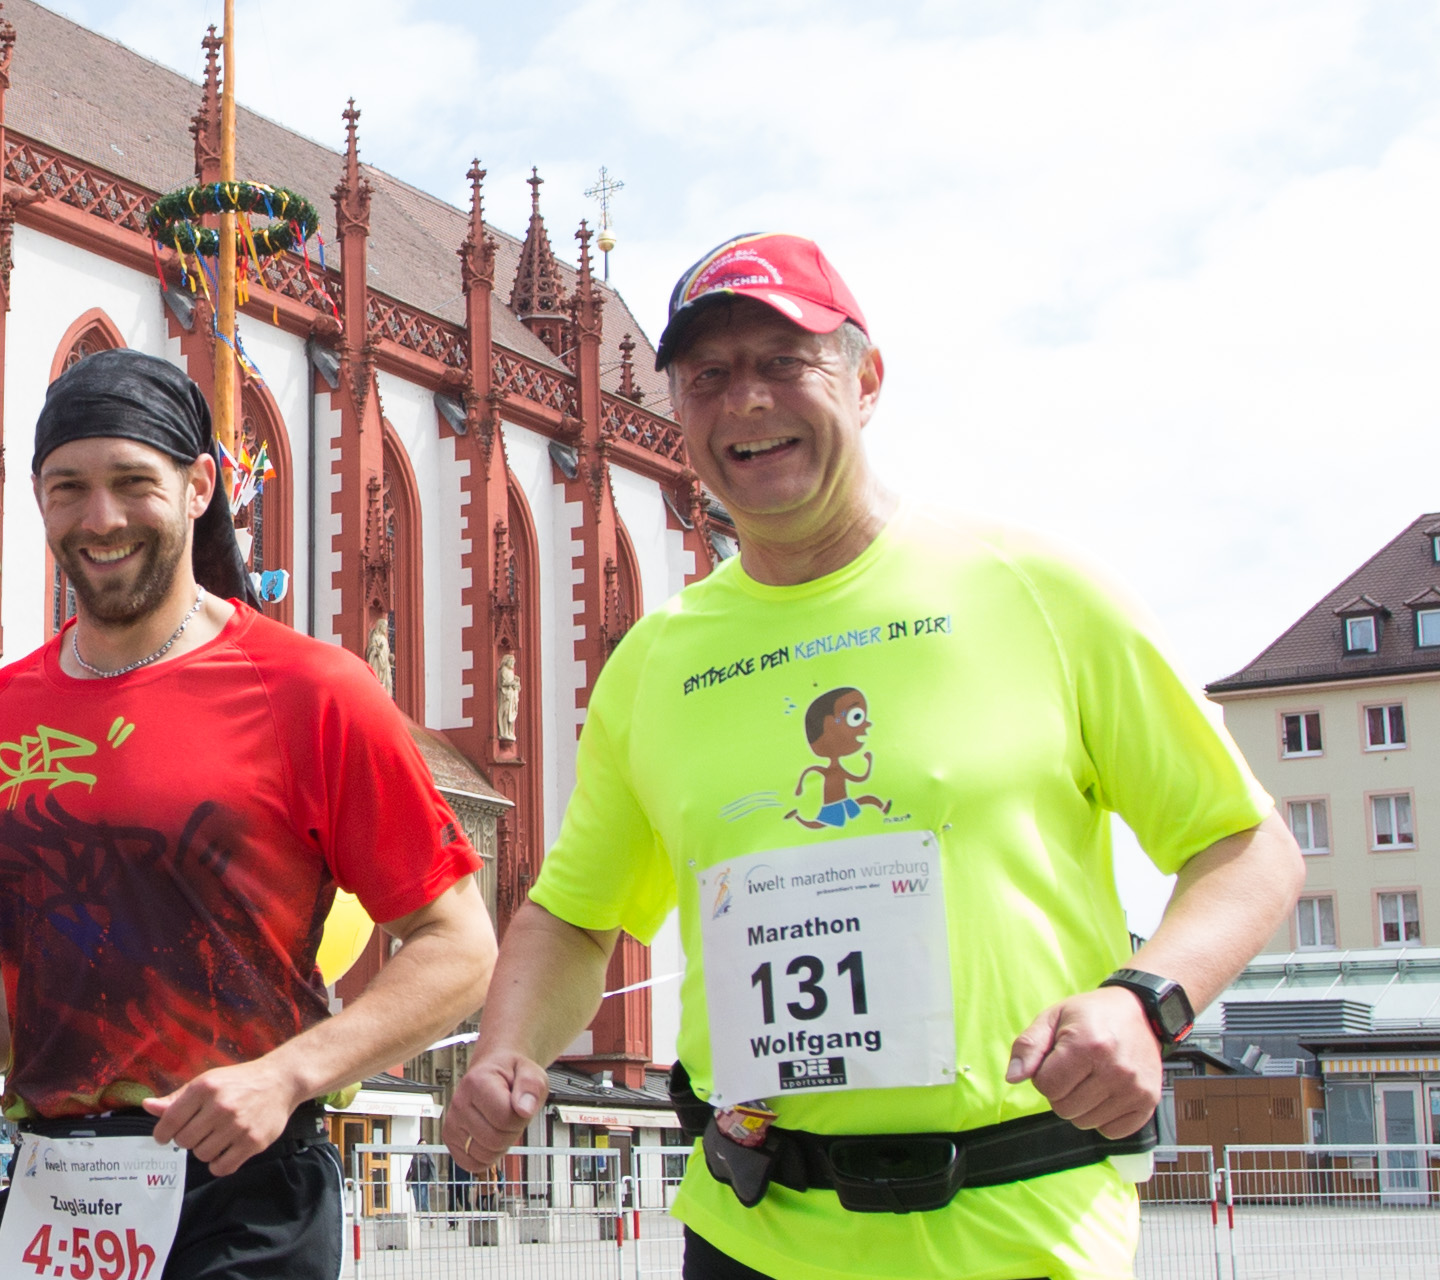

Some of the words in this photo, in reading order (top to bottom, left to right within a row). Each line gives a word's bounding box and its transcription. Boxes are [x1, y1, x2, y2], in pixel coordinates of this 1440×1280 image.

[684, 658, 755, 695] ENTDECKE
[760, 646, 790, 671] DEN
[794, 626, 882, 660] KENIANER
[888, 621, 907, 641] IN
[913, 615, 952, 636] DIR!
[747, 874, 785, 895] iwelt
[791, 864, 856, 888] marathon
[860, 860, 929, 878] würzburg
[748, 916, 860, 946] Marathon
[751, 951, 868, 1025] 131
[750, 1030, 881, 1058] Wolfgang
[792, 1058, 830, 1077] DEE
[782, 1077, 845, 1089] sportswear
[44, 1158, 67, 1171] iwelt
[71, 1158, 120, 1171] marathon
[123, 1158, 177, 1173] würzburg
[50, 1195, 122, 1216] Zugläufer
